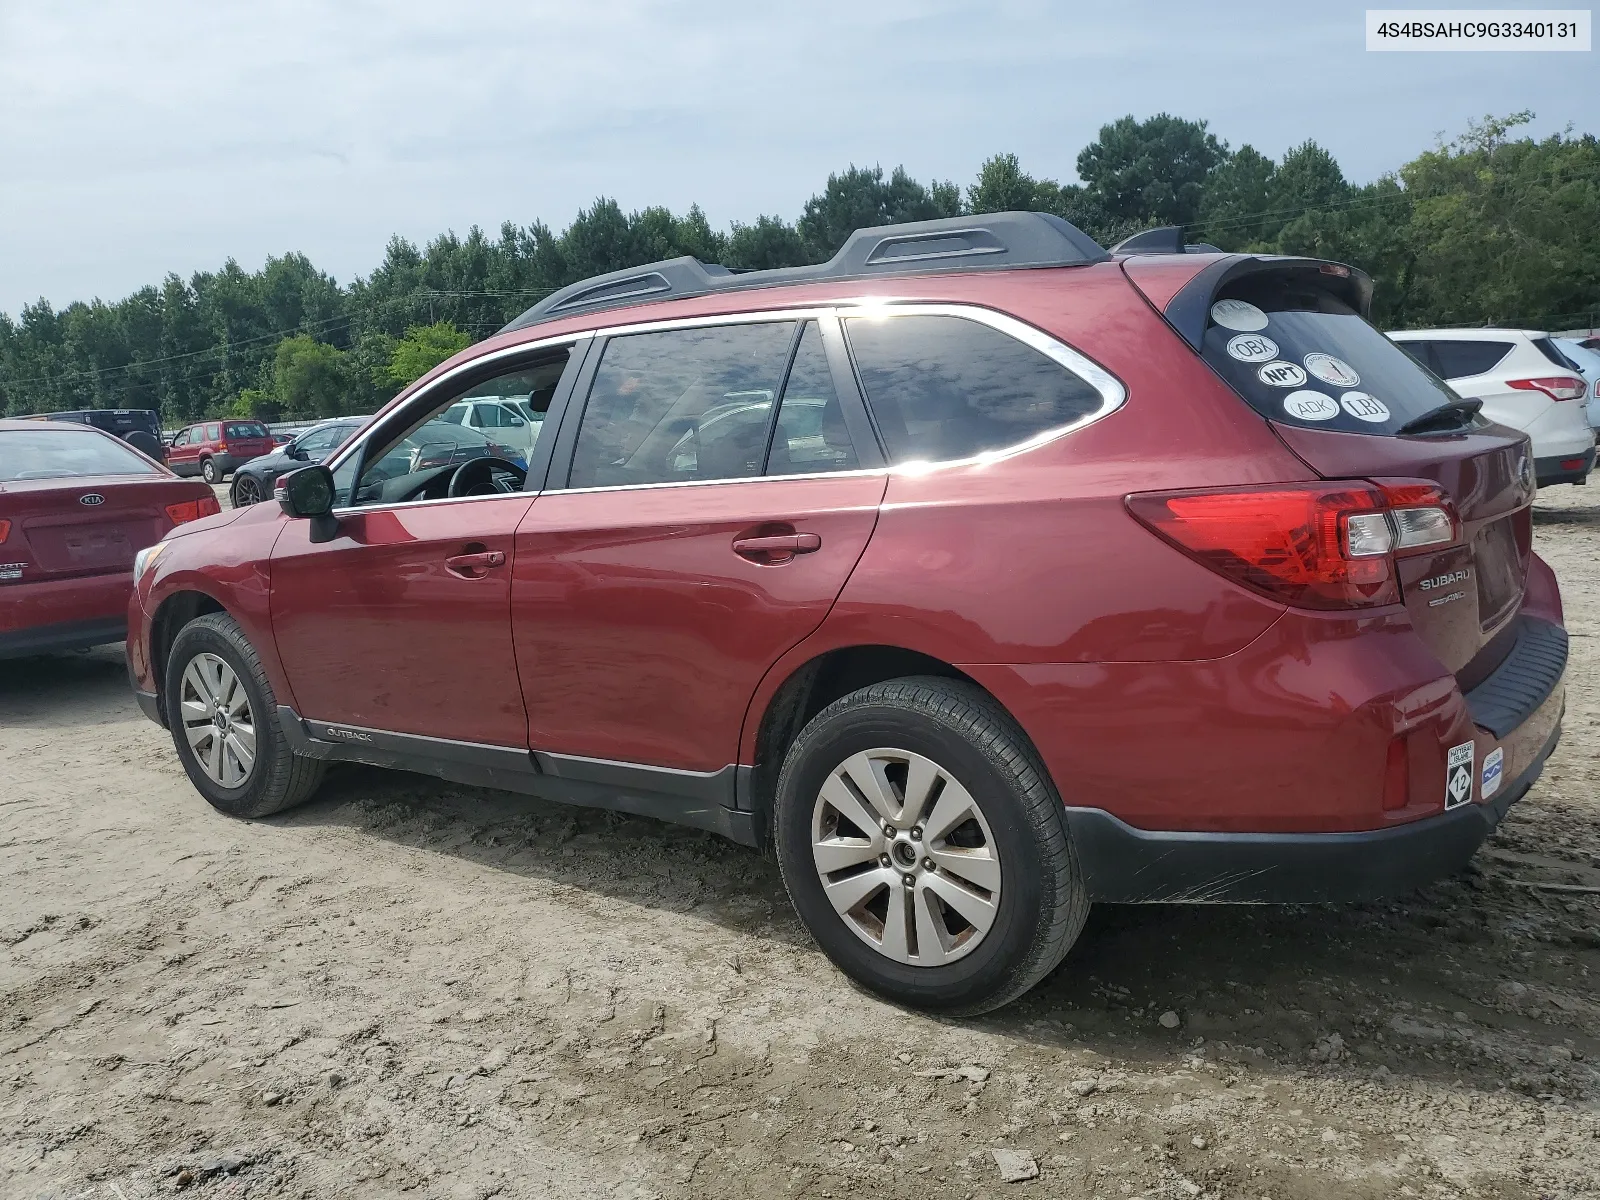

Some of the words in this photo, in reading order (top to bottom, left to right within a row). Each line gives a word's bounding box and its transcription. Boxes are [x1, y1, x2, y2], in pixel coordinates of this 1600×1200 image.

[1235, 338, 1274, 357] OBX
[1264, 366, 1300, 383] NPT
[1297, 400, 1333, 416] ADK
[1345, 397, 1387, 417] LBI
[84, 496, 101, 504] KIA
[1419, 568, 1470, 591] SUBARU
[327, 728, 373, 742] OUTBACK
[1454, 774, 1467, 793] 12
